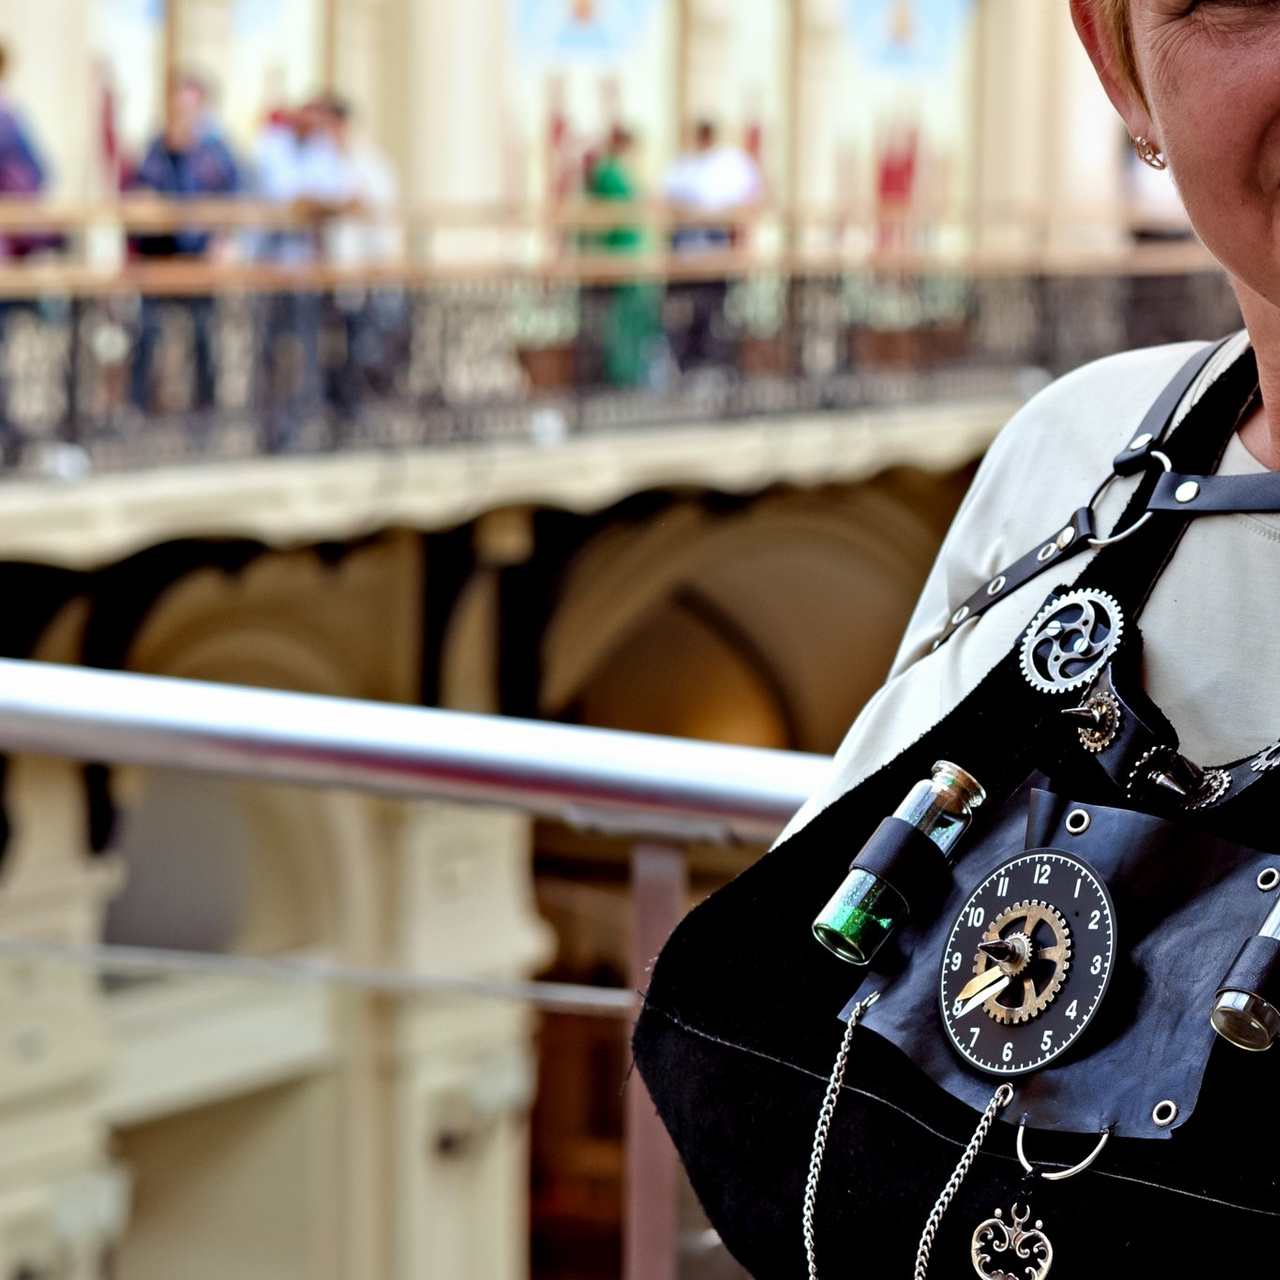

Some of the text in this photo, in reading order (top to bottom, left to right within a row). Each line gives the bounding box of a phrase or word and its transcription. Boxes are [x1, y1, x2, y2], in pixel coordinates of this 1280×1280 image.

[1033, 864, 1051, 884] 12
[997, 877, 1009, 897] 11
[1074, 878, 1082, 898] 1
[968, 907, 984, 927] 10
[1088, 910, 1099, 930] 2
[950, 951, 961, 971] 9
[1090, 955, 1102, 975] 3
[1065, 1000, 1077, 1019] 4
[969, 1027, 981, 1048] 7
[1040, 1030, 1053, 1051] 5
[1002, 1042, 1014, 1062] 6
